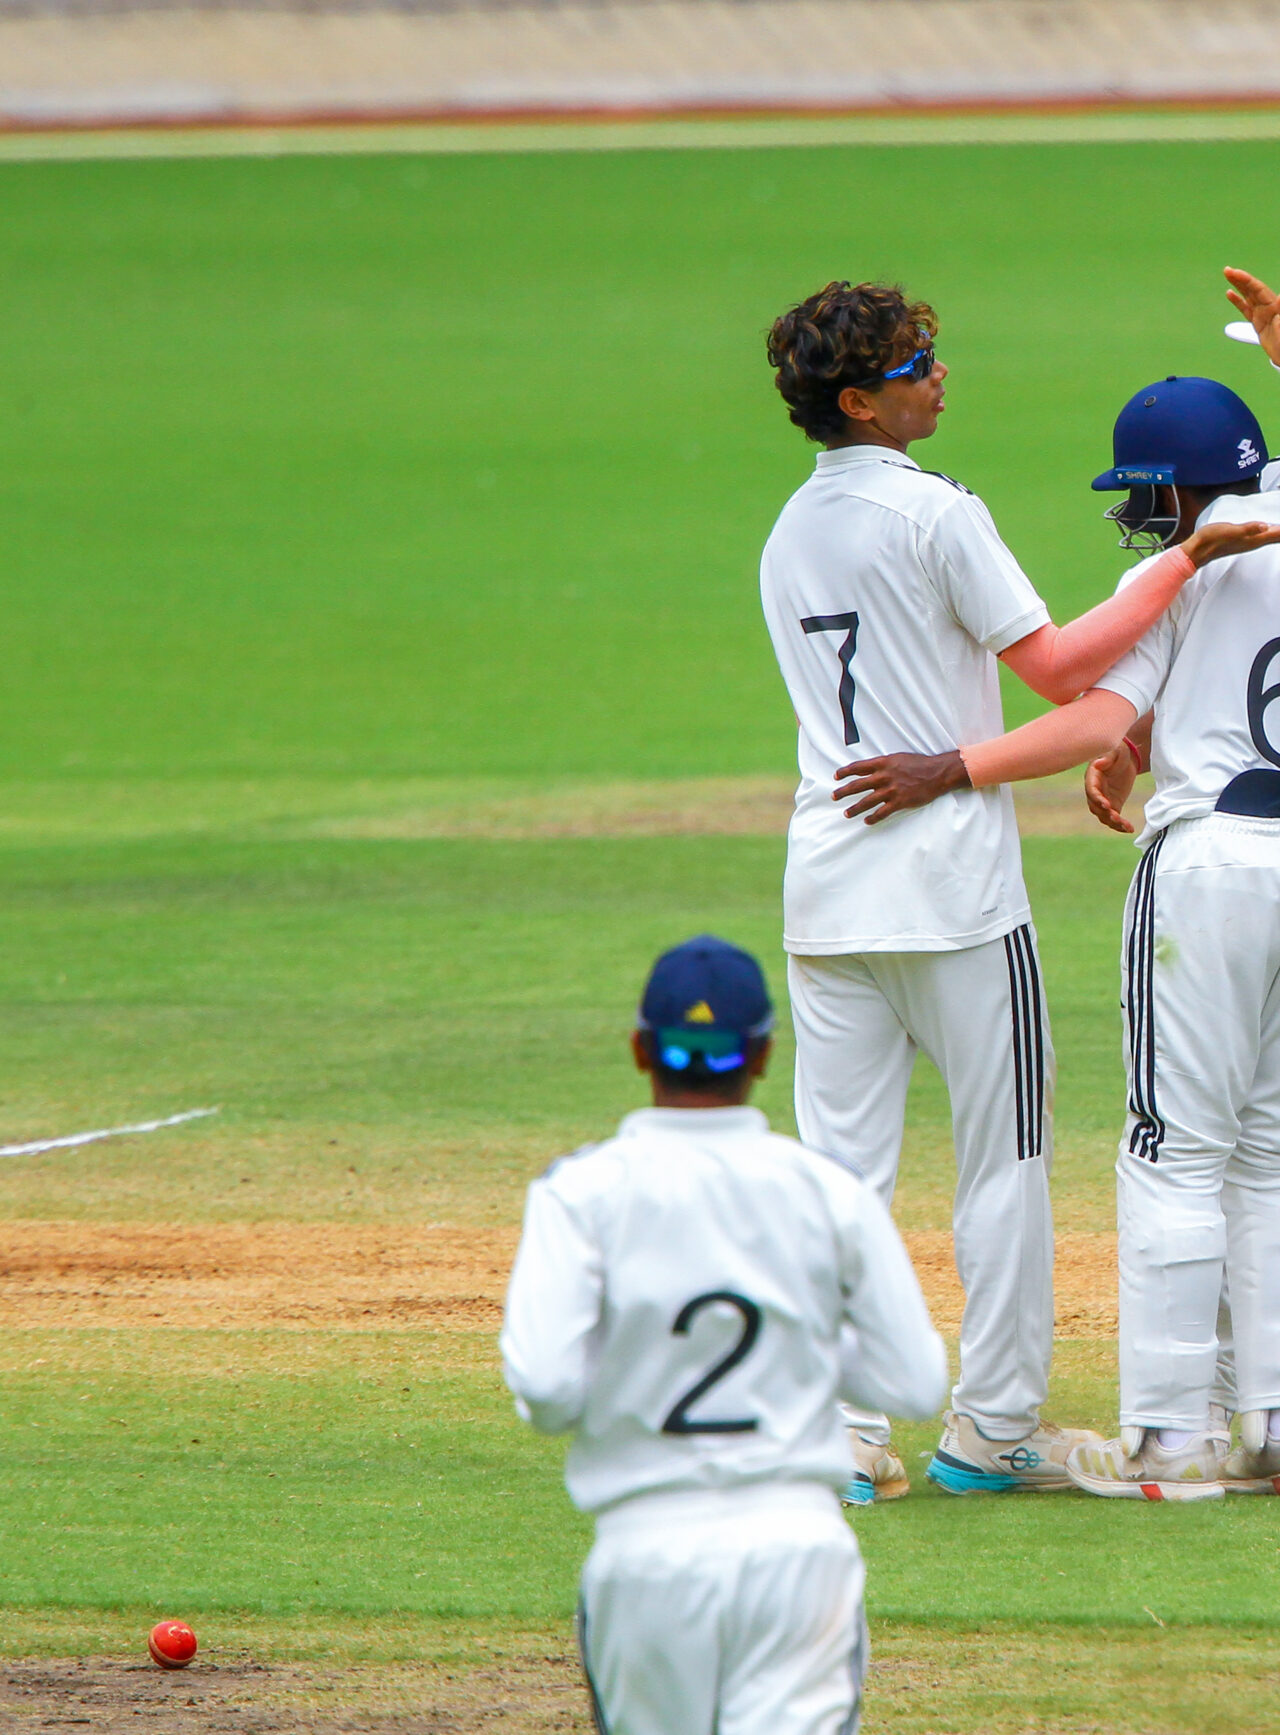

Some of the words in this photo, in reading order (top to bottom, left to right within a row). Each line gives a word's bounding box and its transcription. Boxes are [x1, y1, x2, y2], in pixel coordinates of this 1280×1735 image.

[1125, 471, 1153, 480] SHREY
[1237, 451, 1260, 469] SHREY
[800, 611, 860, 746] 7
[661, 1291, 763, 1436] 2
